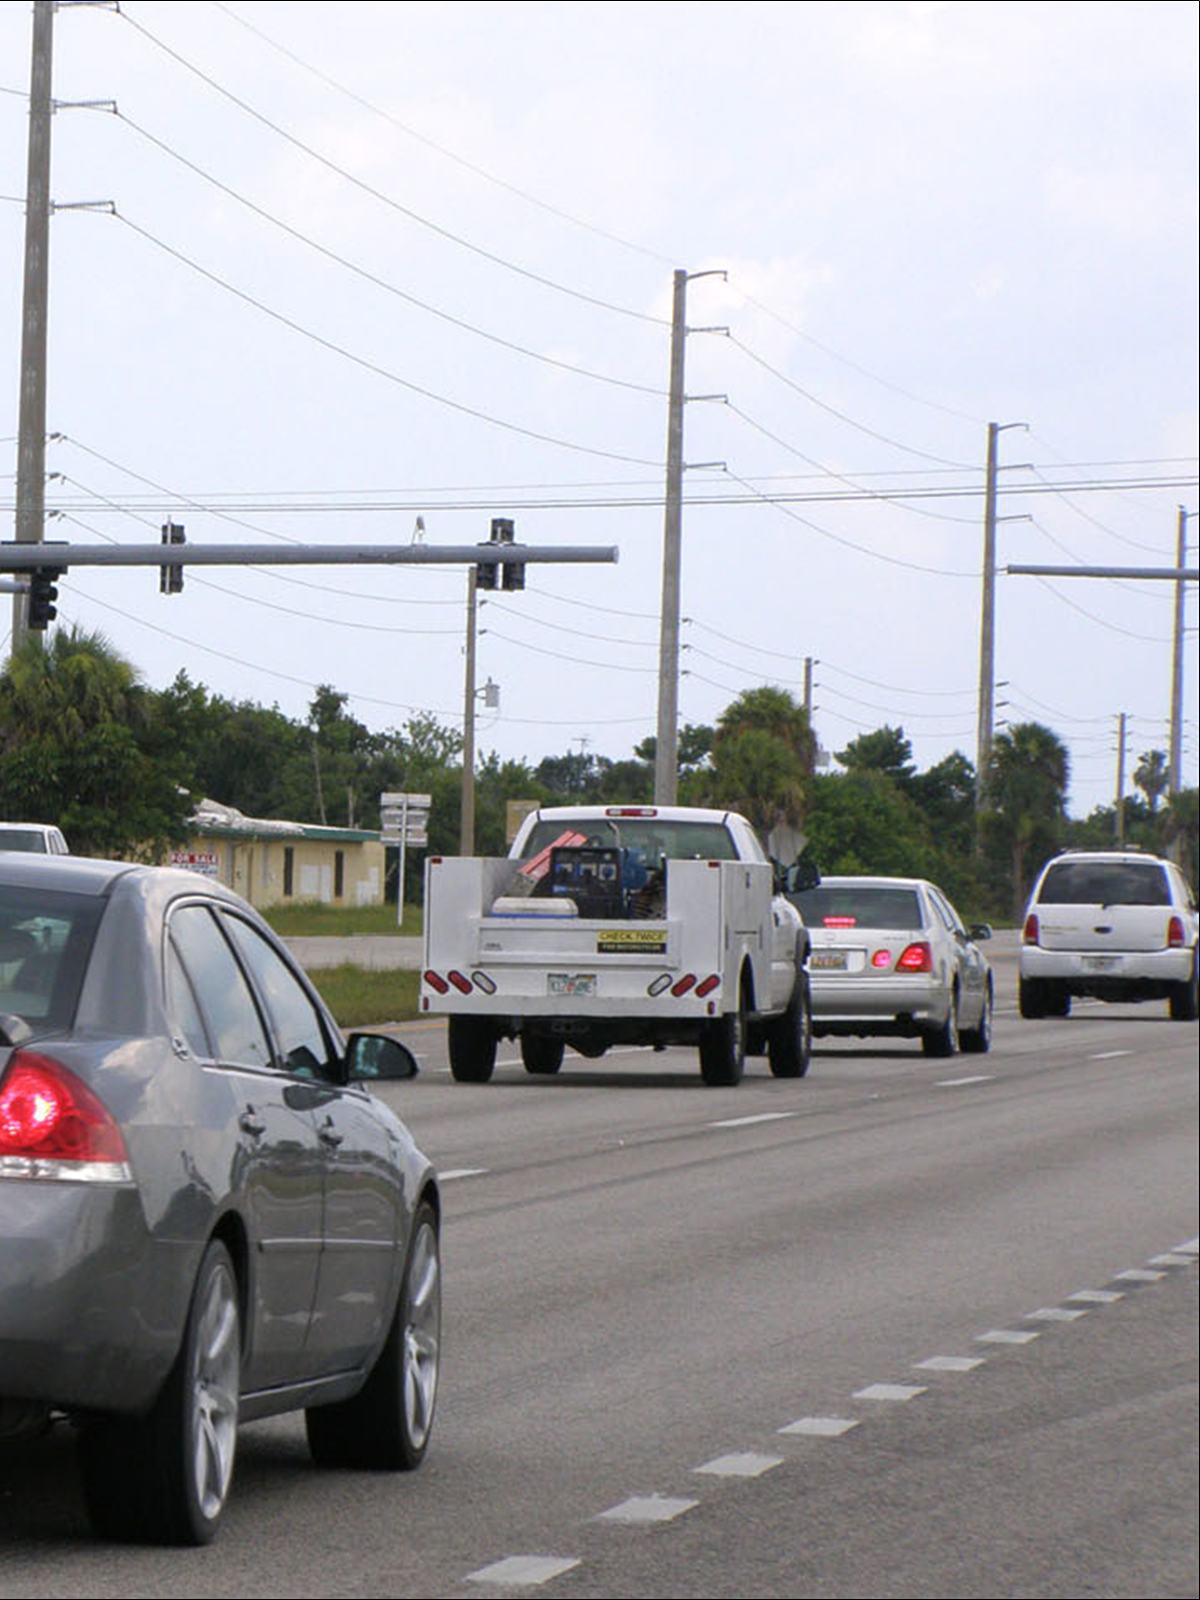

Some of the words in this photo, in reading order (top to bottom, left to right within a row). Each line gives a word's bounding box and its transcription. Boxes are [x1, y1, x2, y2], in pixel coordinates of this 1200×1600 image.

[171, 853, 189, 864] FOR
[195, 853, 217, 865] SALE
[600, 930, 633, 941] CHECK
[636, 931, 664, 941] TWICE
